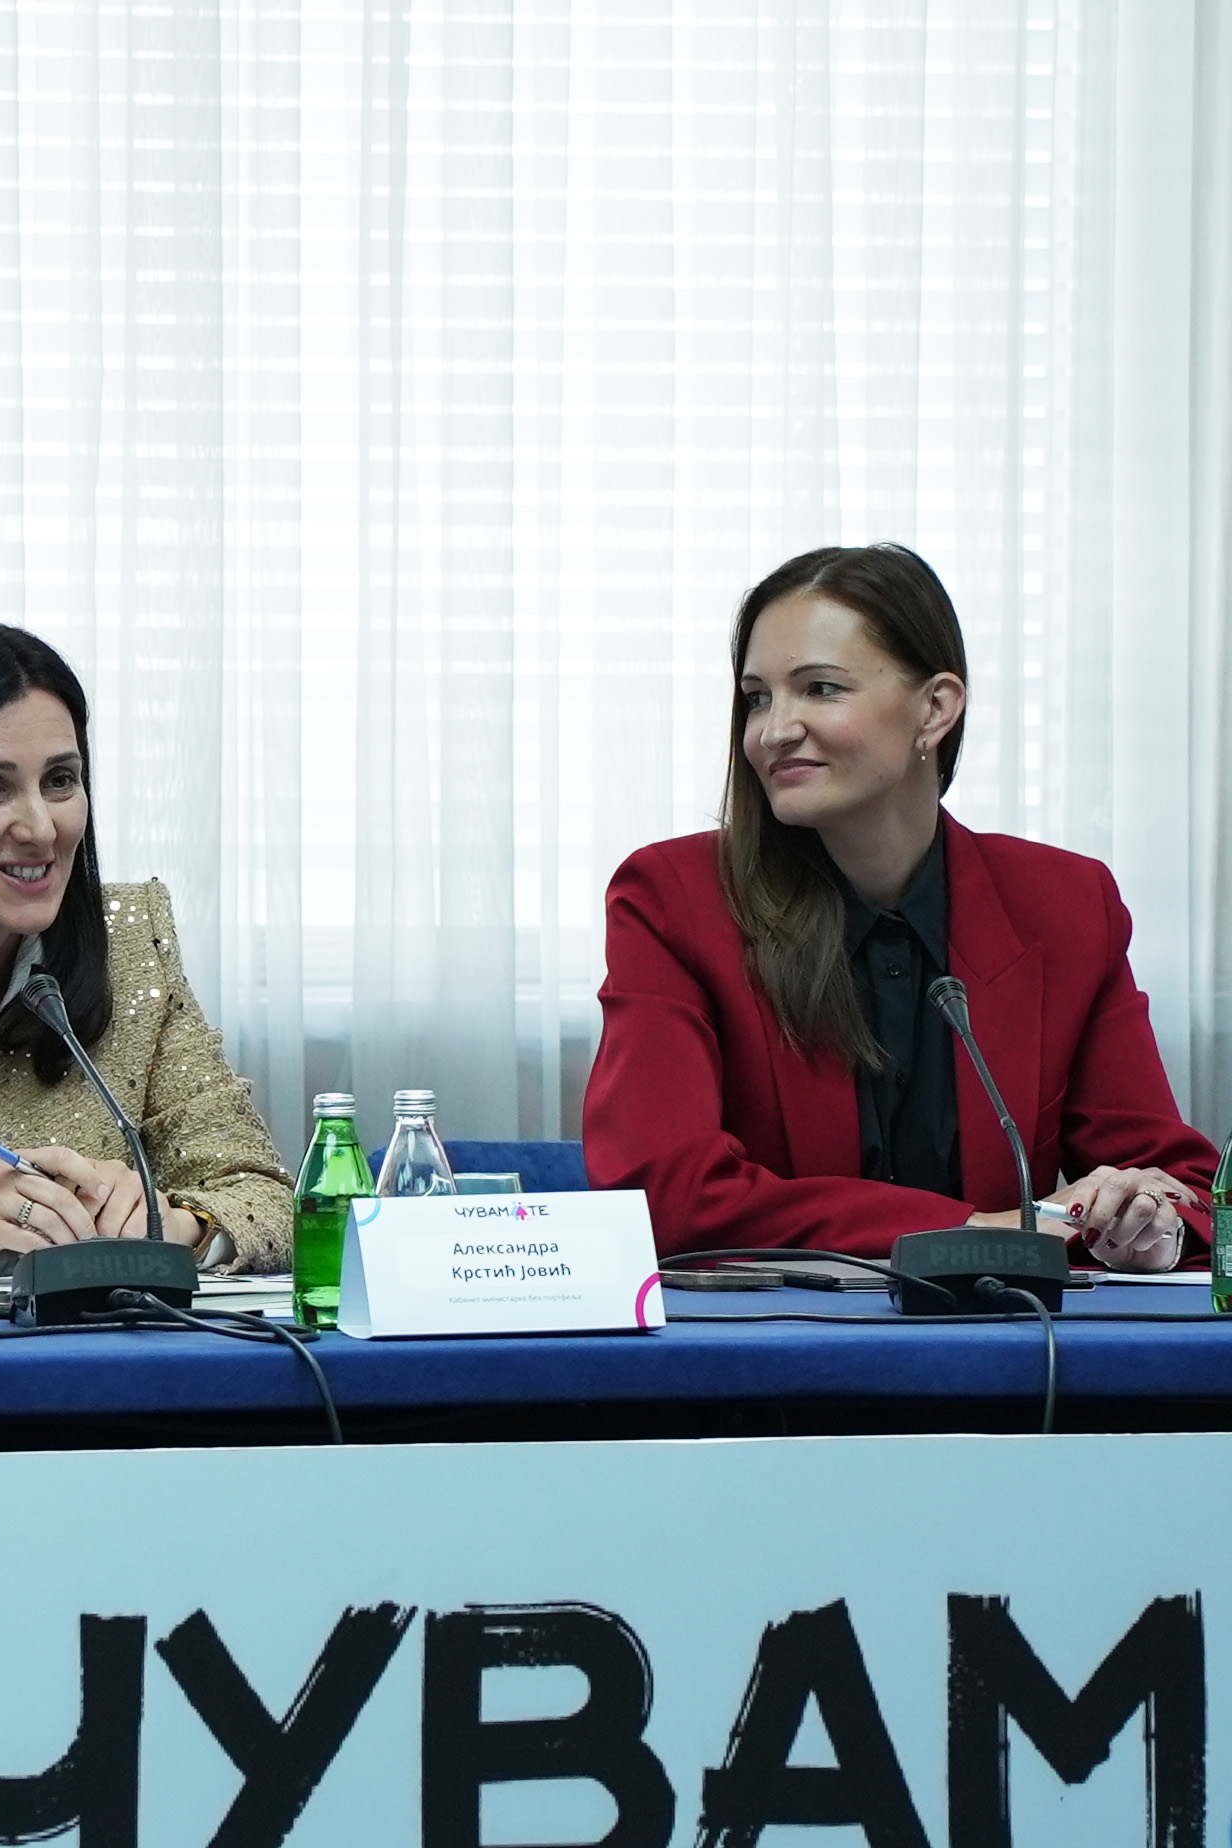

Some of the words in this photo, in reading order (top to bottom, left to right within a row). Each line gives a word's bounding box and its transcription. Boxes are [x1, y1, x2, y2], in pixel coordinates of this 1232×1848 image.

[454, 1205, 510, 1218] ЧУВАМ
[527, 1204, 550, 1217] ТЕ
[453, 1241, 559, 1257] Александра
[929, 1243, 1042, 1267] PHILIPS
[63, 1253, 172, 1278] PHILIPS
[452, 1264, 516, 1283] Крстић
[520, 1263, 571, 1281] Јовић
